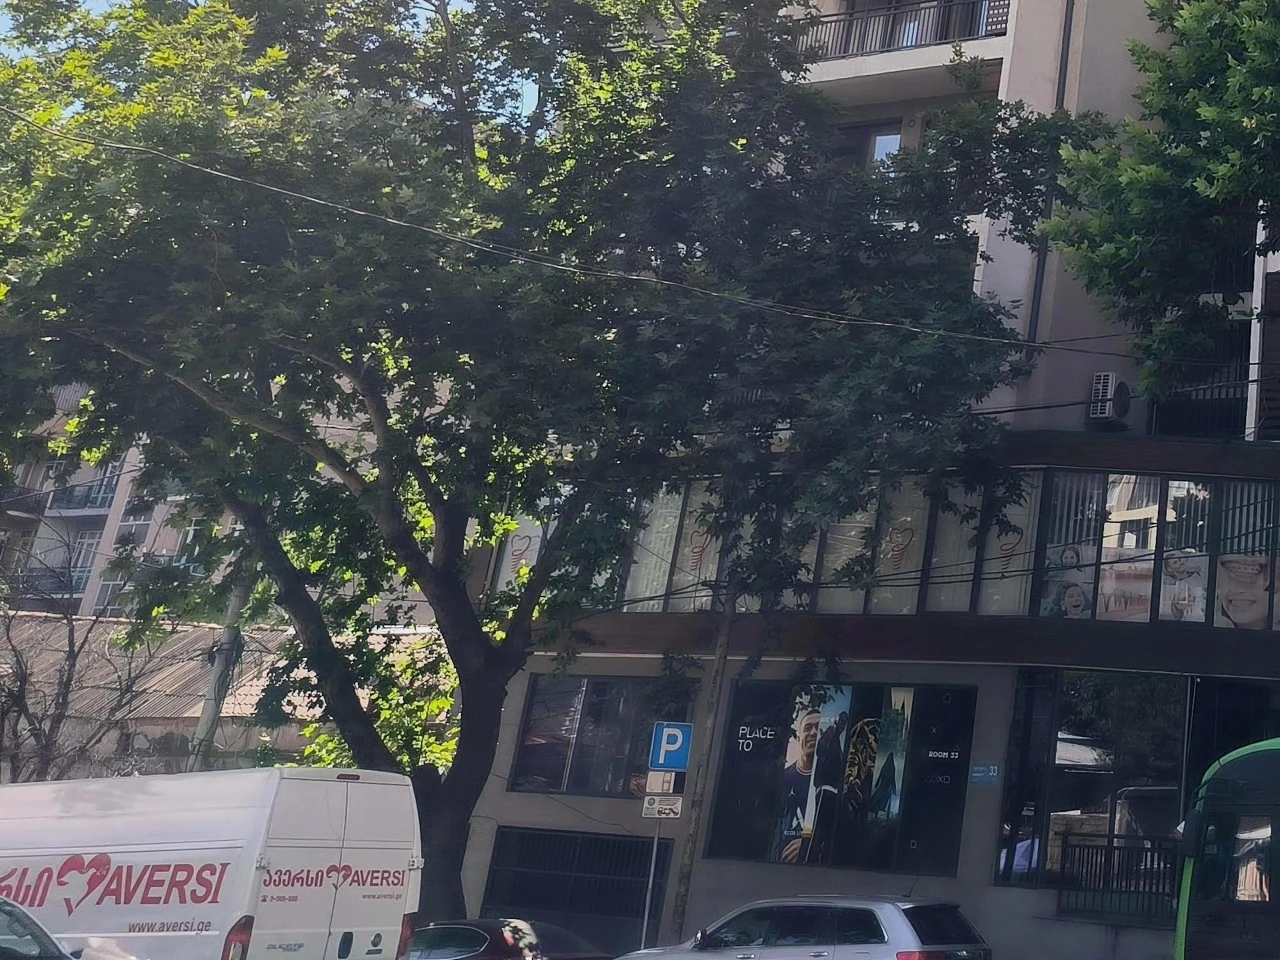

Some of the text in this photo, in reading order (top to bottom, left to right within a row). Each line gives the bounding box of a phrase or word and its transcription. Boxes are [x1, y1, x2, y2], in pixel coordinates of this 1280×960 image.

[738, 726, 776, 739] PLACE
[658, 727, 684, 764] P
[738, 740, 753, 751] TO
[928, 750, 959, 759] ROOM 33
[989, 765, 998, 776] 33
[96, 863, 232, 905] AVERSI
[263, 869, 324, 887] ავერსი
[349, 870, 406, 887] AVERSI
[361, 892, 403, 901] www.aversi.ge
[128, 918, 212, 935] www.aversi.ge
